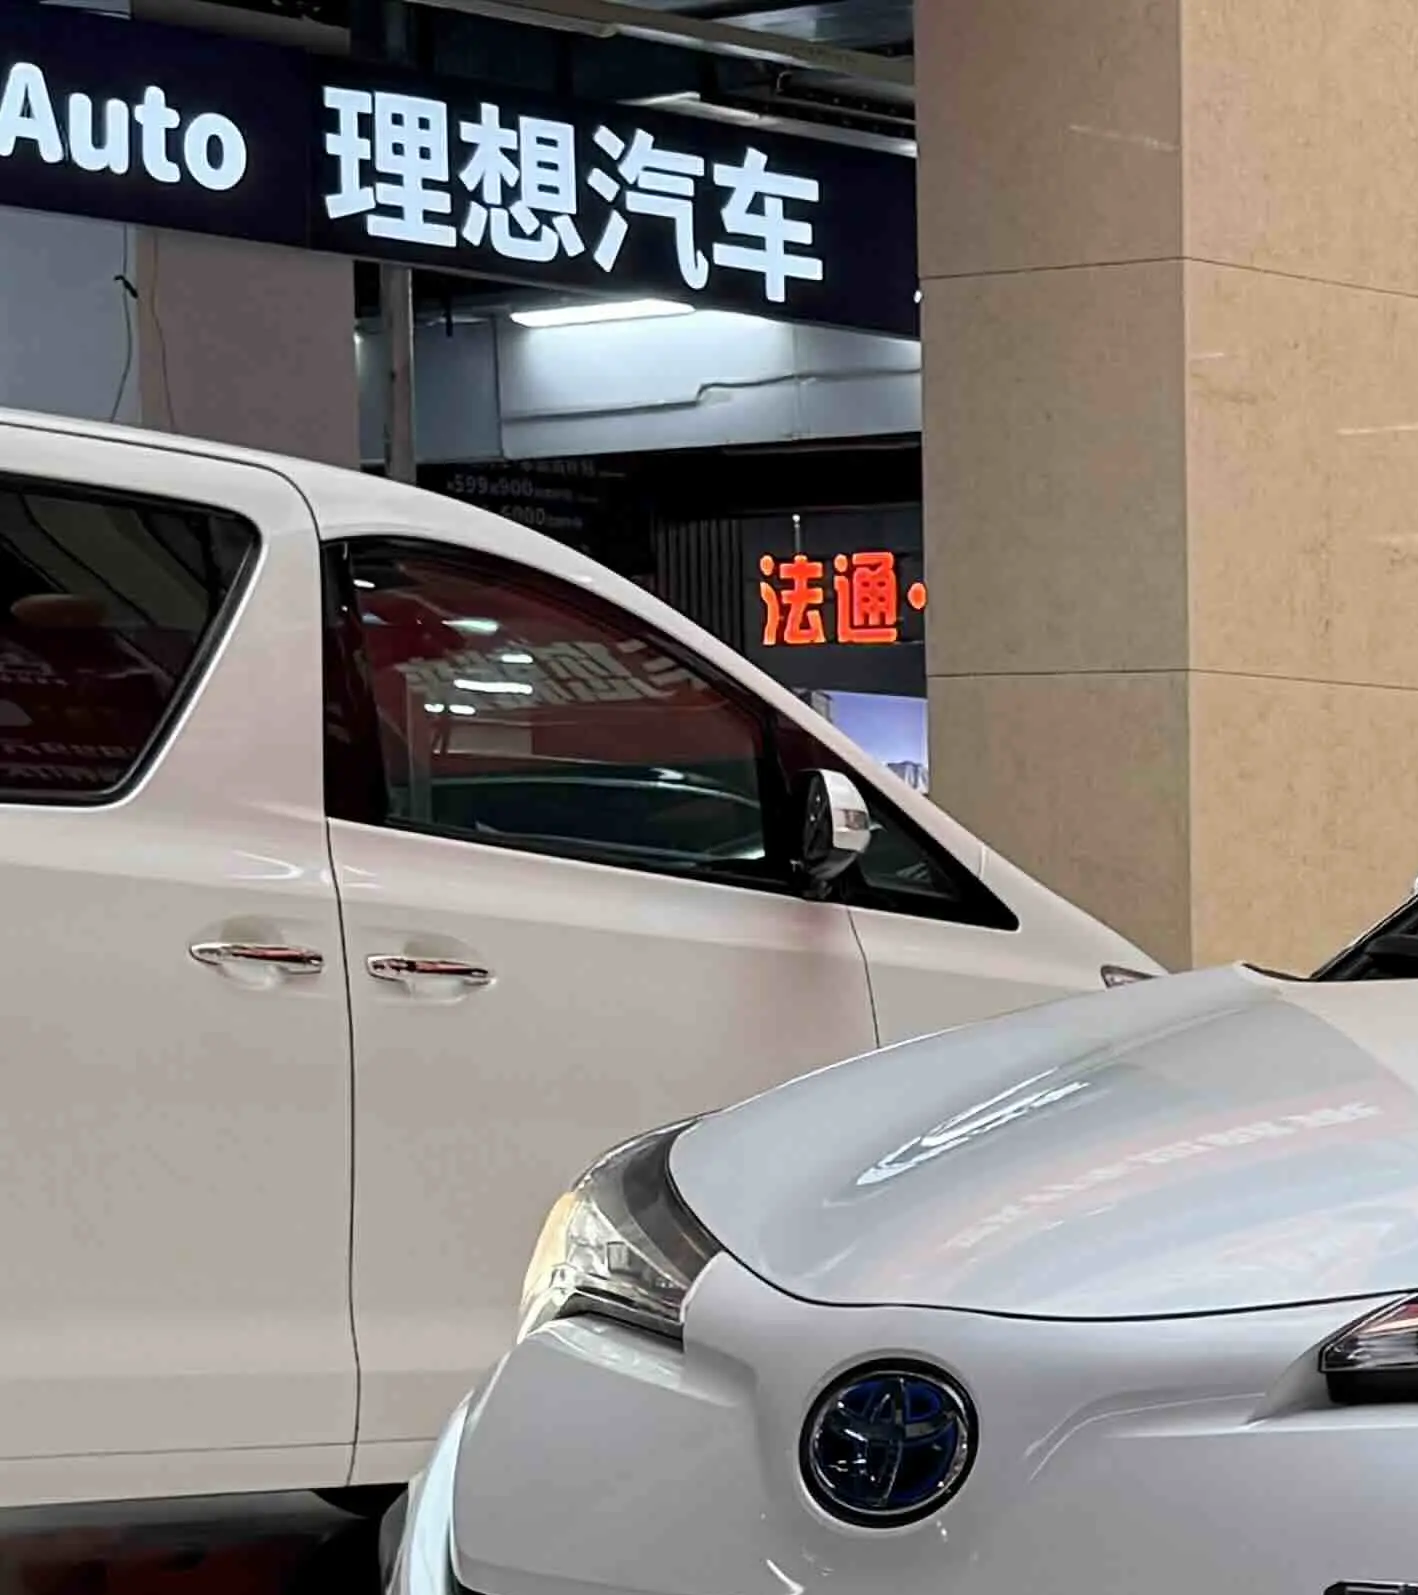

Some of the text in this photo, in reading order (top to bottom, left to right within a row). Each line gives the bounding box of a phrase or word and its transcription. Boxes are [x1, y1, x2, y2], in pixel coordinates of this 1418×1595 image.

[0, 62, 248, 192] Auto
[321, 85, 824, 304] 理想汽车
